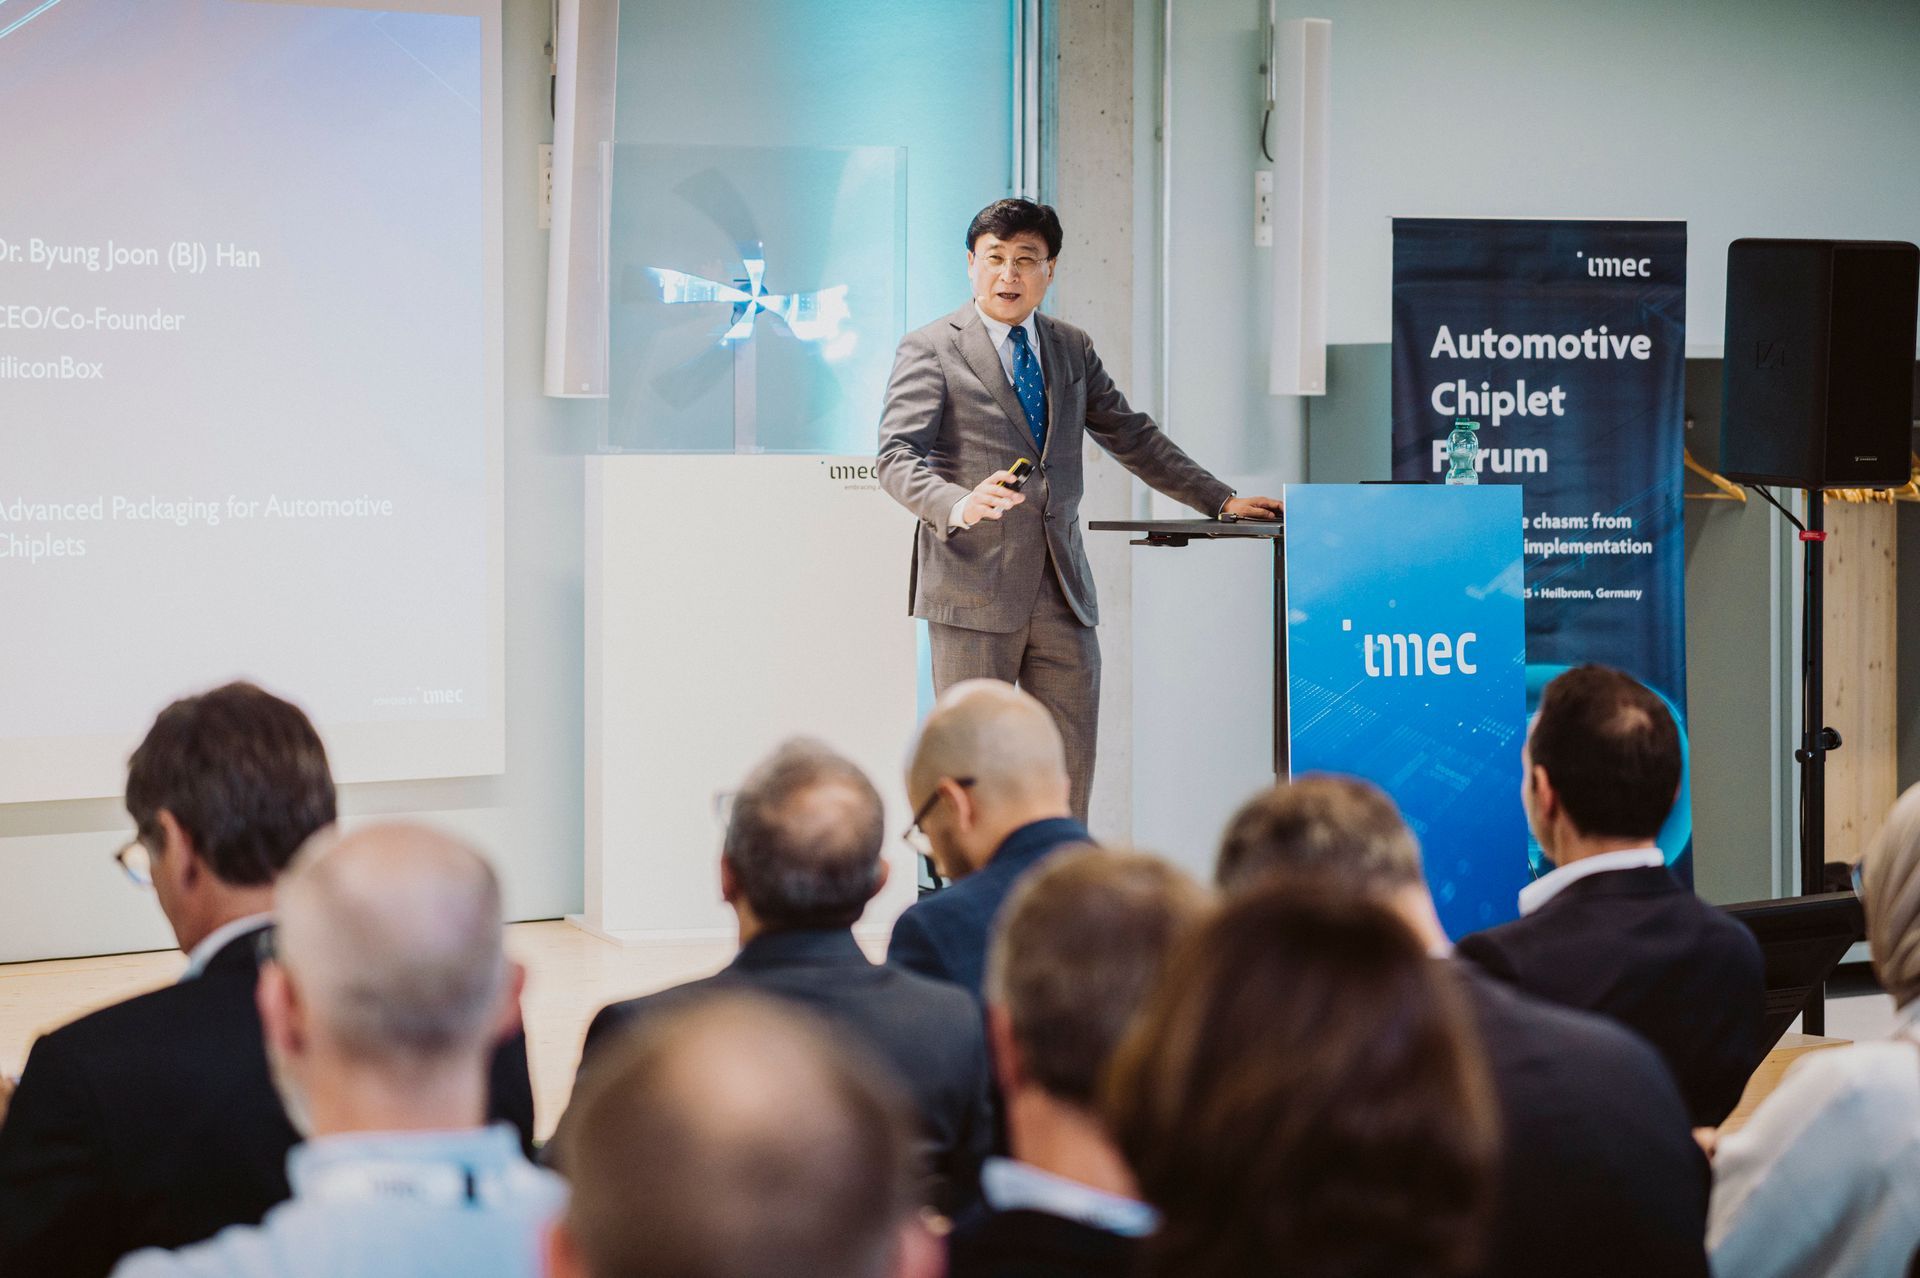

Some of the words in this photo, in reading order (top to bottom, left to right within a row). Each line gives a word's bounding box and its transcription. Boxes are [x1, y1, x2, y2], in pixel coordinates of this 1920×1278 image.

[30, 238, 100, 271] Byung
[105, 240, 159, 271] Joon
[168, 242, 207, 273] (BJ)
[216, 243, 260, 267] Han
[1577, 251, 1651, 277] imec
[1430, 325, 1652, 360] Automotive
[0, 355, 103, 379] iliconBox
[1431, 379, 1566, 426] Chiplet
[1432, 440, 1548, 473] Frum
[112, 496, 220, 525] Packaging
[226, 495, 259, 519] for
[264, 493, 393, 518] Automotive
[1533, 512, 1588, 529] chasm:
[1592, 512, 1632, 529] from
[1524, 537, 1652, 559] implementation
[1541, 587, 1594, 600] Heilbronn,
[1596, 588, 1642, 600] Germany
[1342, 619, 1477, 677] imec
